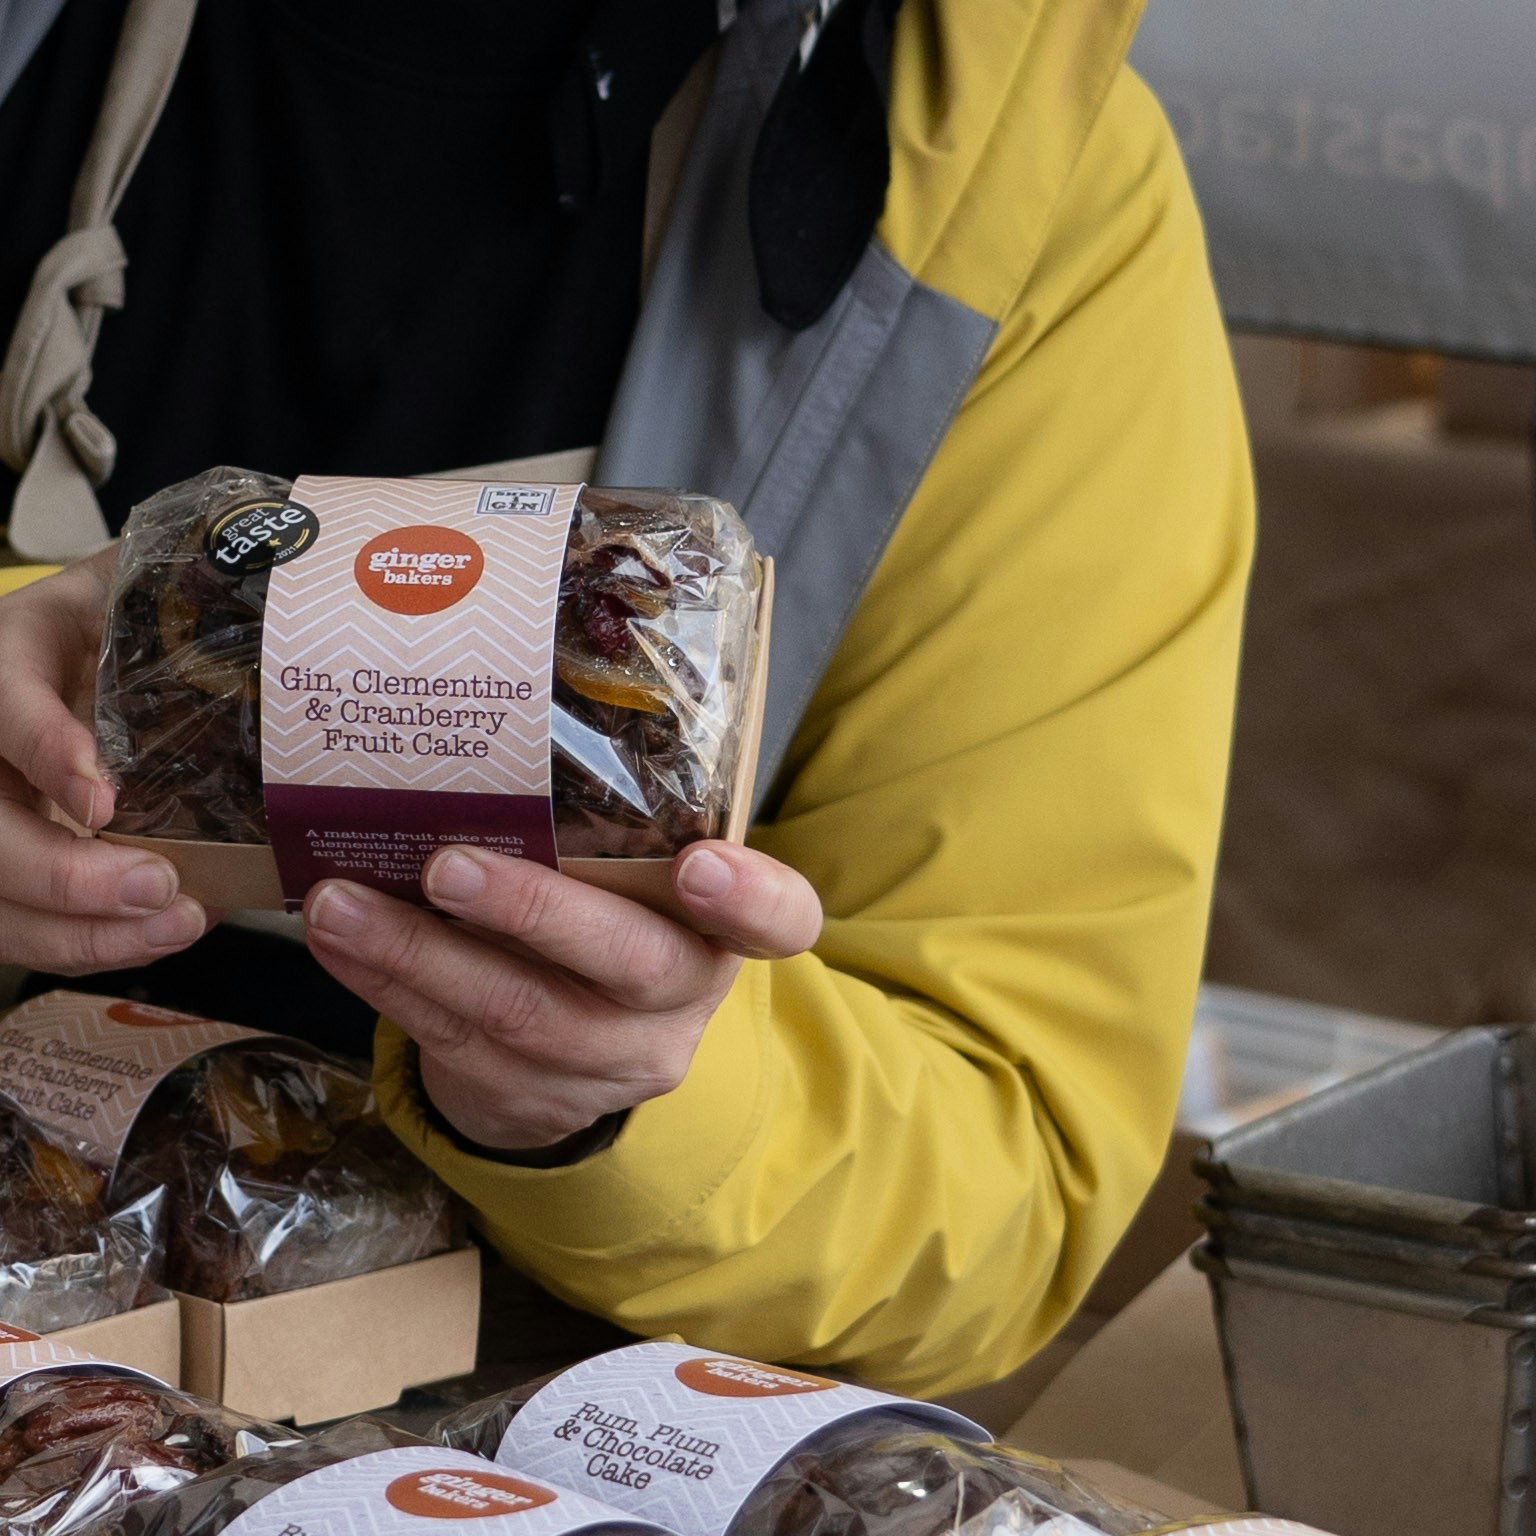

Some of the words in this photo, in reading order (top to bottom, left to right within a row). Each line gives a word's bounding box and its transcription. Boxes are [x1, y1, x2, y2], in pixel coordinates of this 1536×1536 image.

[491, 502, 538, 510] GIN
[216, 509, 306, 563] taste
[222, 509, 269, 541] great
[368, 547, 472, 572] ginger
[383, 569, 452, 585] bakers
[281, 666, 343, 697] Gin,
[352, 669, 533, 700] Clementine
[305, 698, 332, 722] &
[341, 699, 507, 736] Cranberry
[322, 728, 404, 754] Fruit
[412, 732, 489, 758] Cake
[305, 829, 319, 838] A
[324, 830, 389, 841] mature
[394, 832, 435, 841] fruit
[439, 833, 479, 843] cake
[483, 835, 525, 845] with
[310, 839, 414, 851] clementine,
[312, 849, 345, 858] and
[350, 851, 389, 860] vine
[334, 859, 374, 868] with
[379, 861, 421, 869] Shed
[703, 1359, 820, 1390] ginger
[706, 1367, 780, 1390] bakers
[570, 1401, 638, 1439] Rum,
[646, 1423, 721, 1458] Plum
[553, 1418, 582, 1441] &
[583, 1427, 714, 1481] Chocolate
[587, 1453, 652, 1490] Cake
[416, 1472, 534, 1508] ginger
[416, 1482, 491, 1511] bakers
